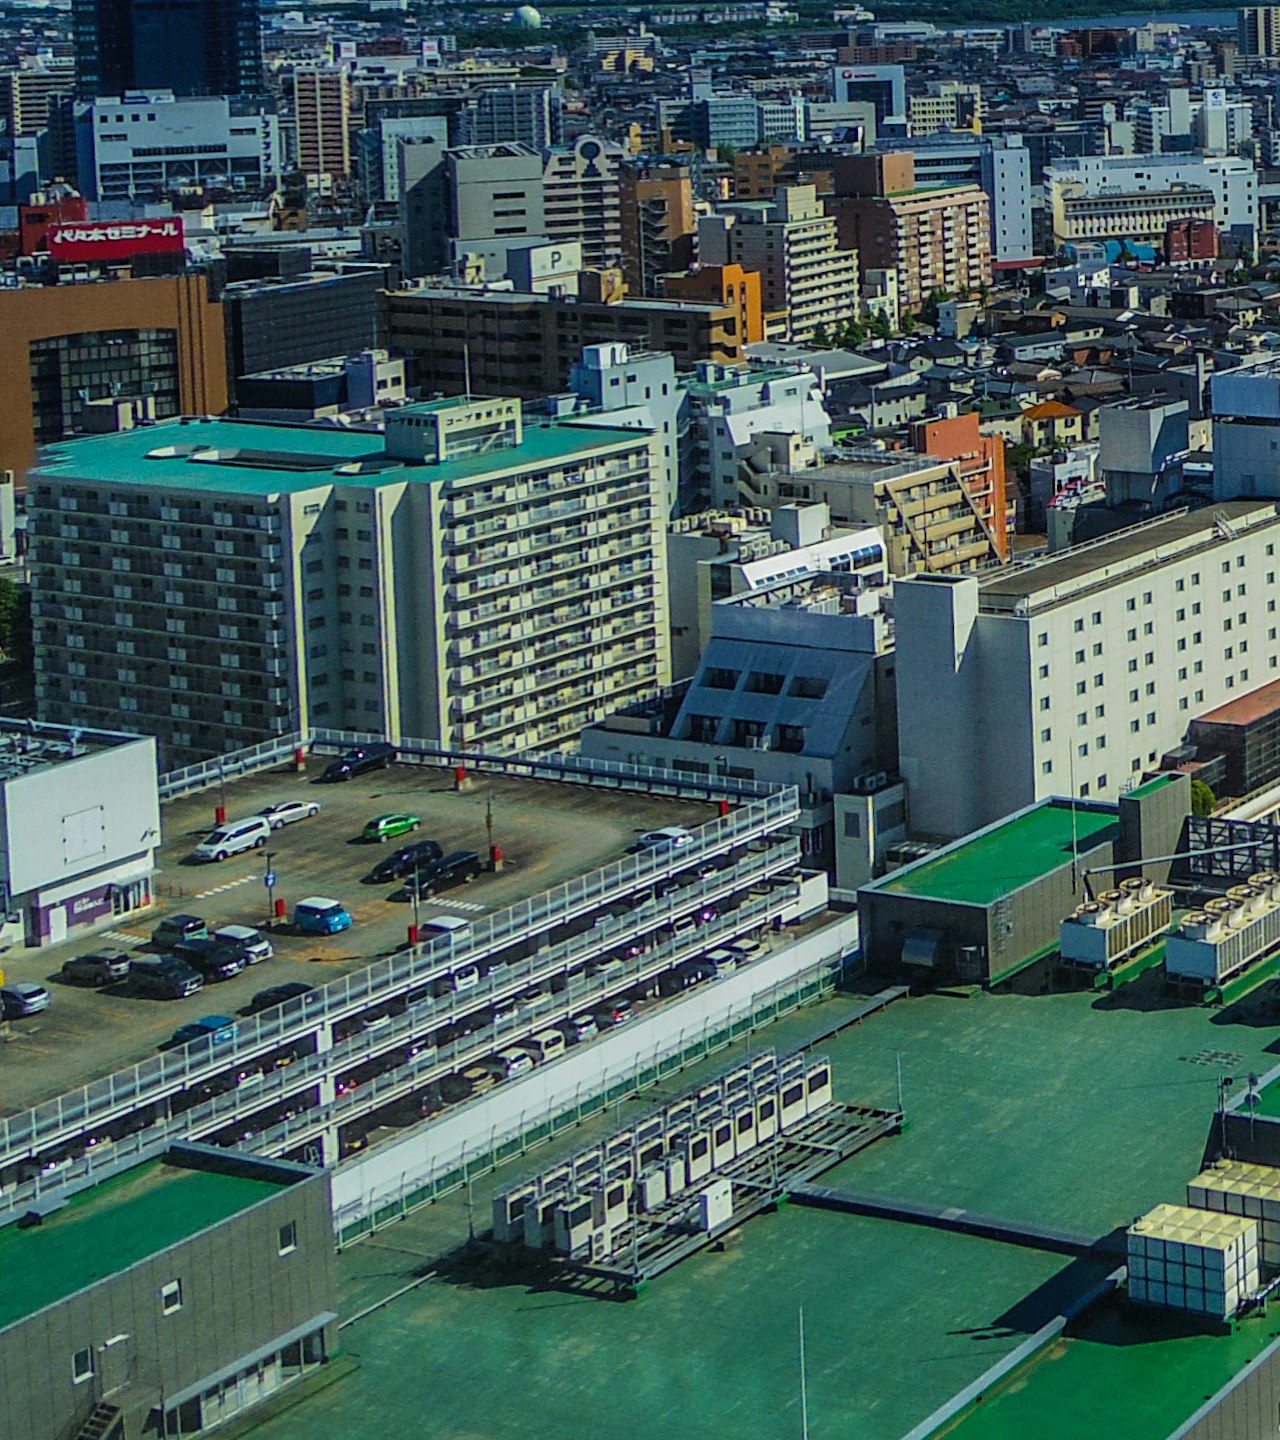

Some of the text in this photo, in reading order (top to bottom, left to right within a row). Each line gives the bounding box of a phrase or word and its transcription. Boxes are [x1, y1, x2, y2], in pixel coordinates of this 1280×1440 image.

[53, 223, 179, 244] 代々木ゼミナール
[551, 251, 562, 269] P
